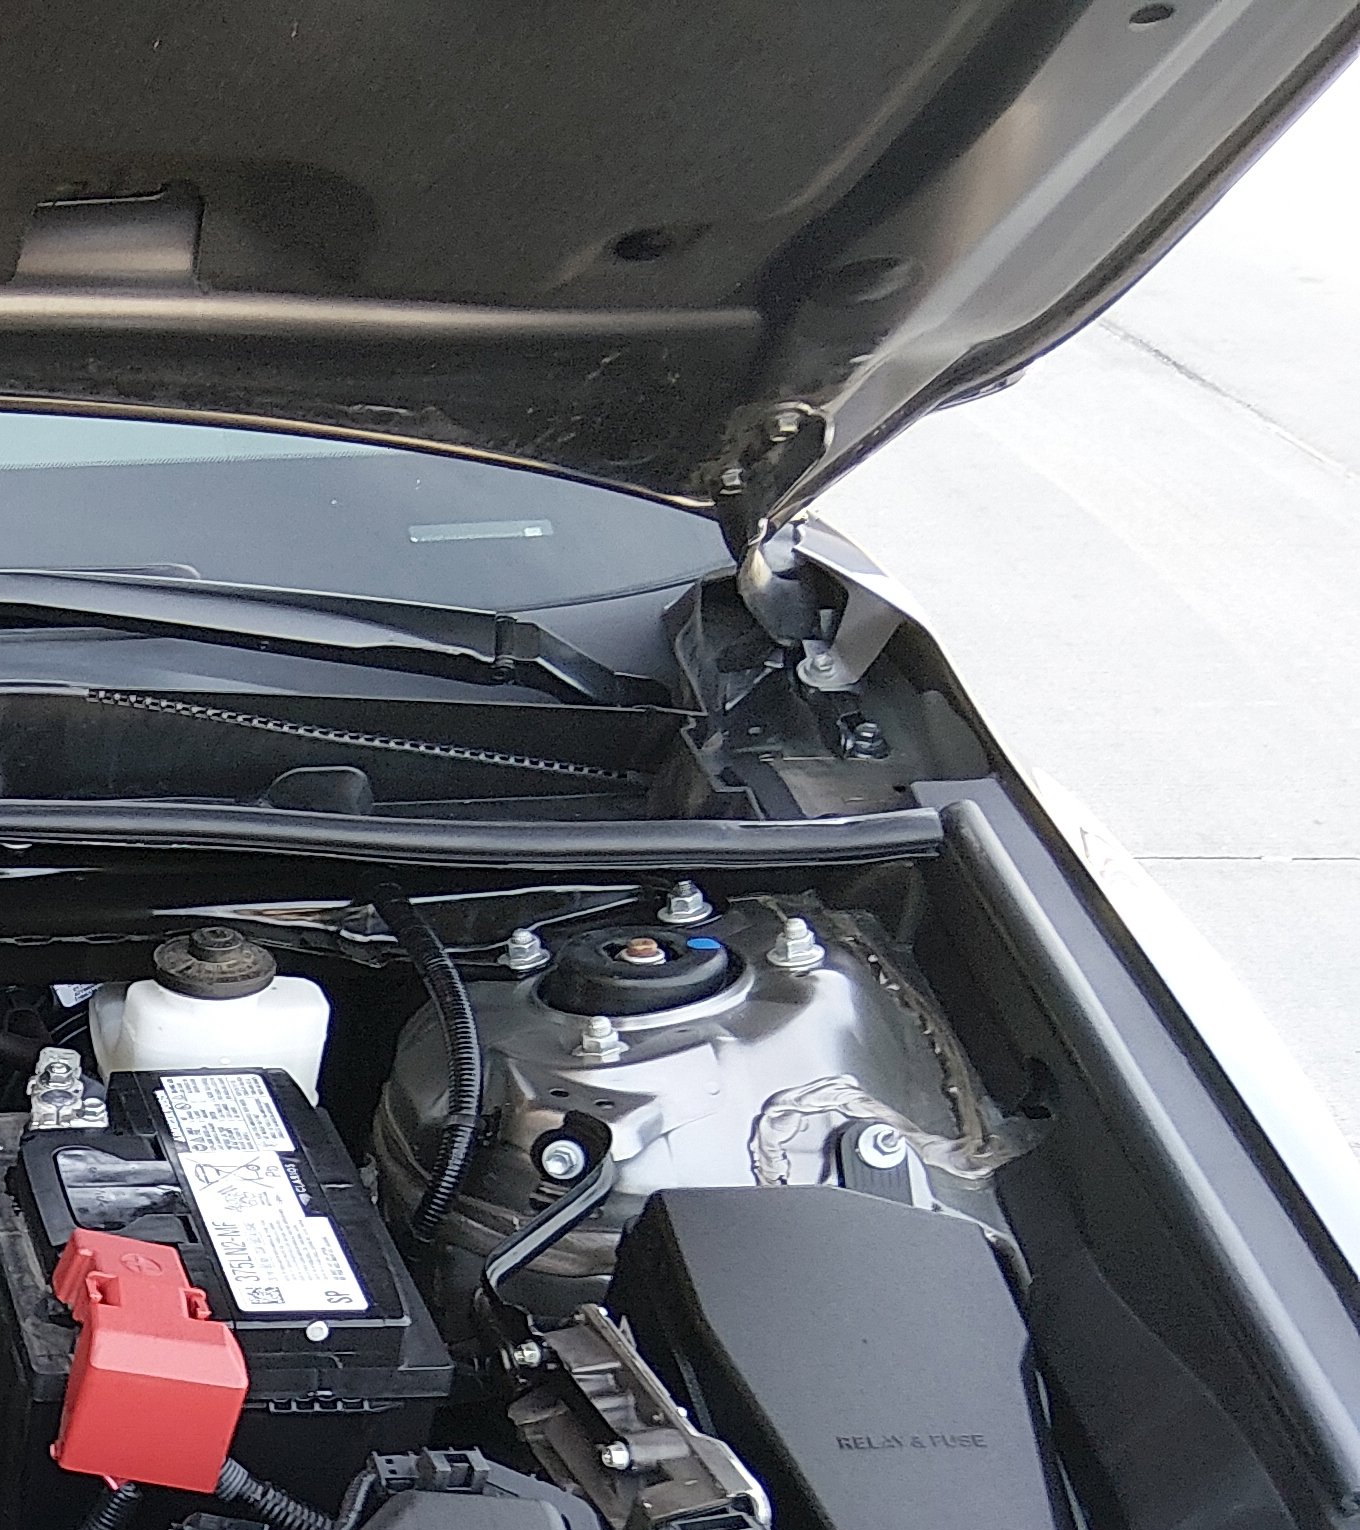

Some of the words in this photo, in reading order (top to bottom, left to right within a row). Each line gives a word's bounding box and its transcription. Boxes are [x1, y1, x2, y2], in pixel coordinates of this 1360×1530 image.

[284, 1162, 307, 1194] CLARIOS
[324, 1290, 353, 1304] SP
[835, 1435, 904, 1450] RELAY
[910, 1435, 927, 1449] &
[929, 1434, 988, 1449] FUSE
